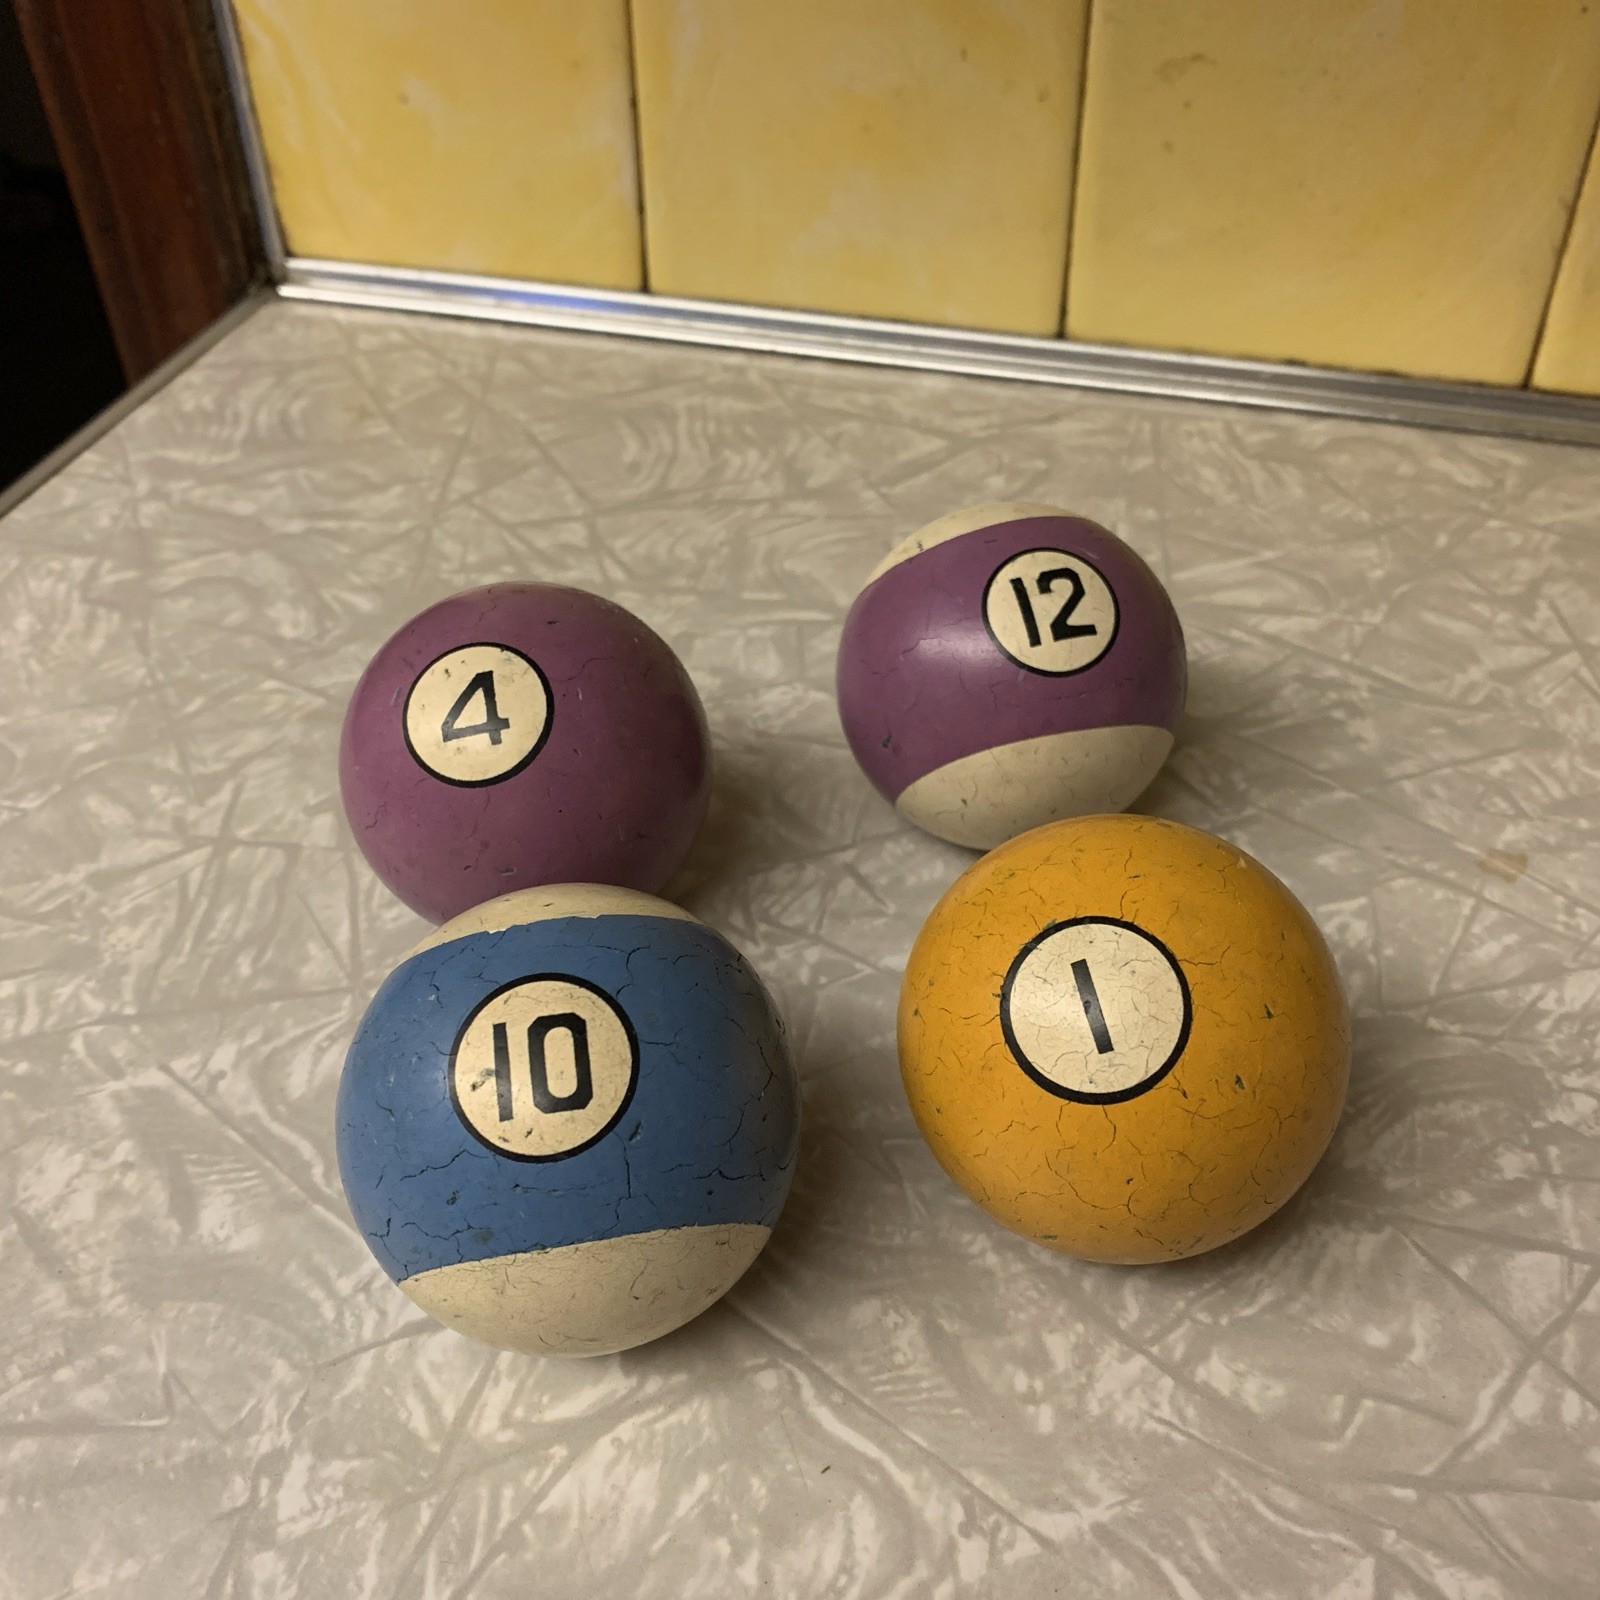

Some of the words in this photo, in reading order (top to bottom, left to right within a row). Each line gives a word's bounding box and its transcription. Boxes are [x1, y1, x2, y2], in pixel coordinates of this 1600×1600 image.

[1009, 566, 1098, 648] 12
[441, 669, 511, 746] 4
[1070, 958, 1114, 1055] 1
[492, 1011, 594, 1123] 10
